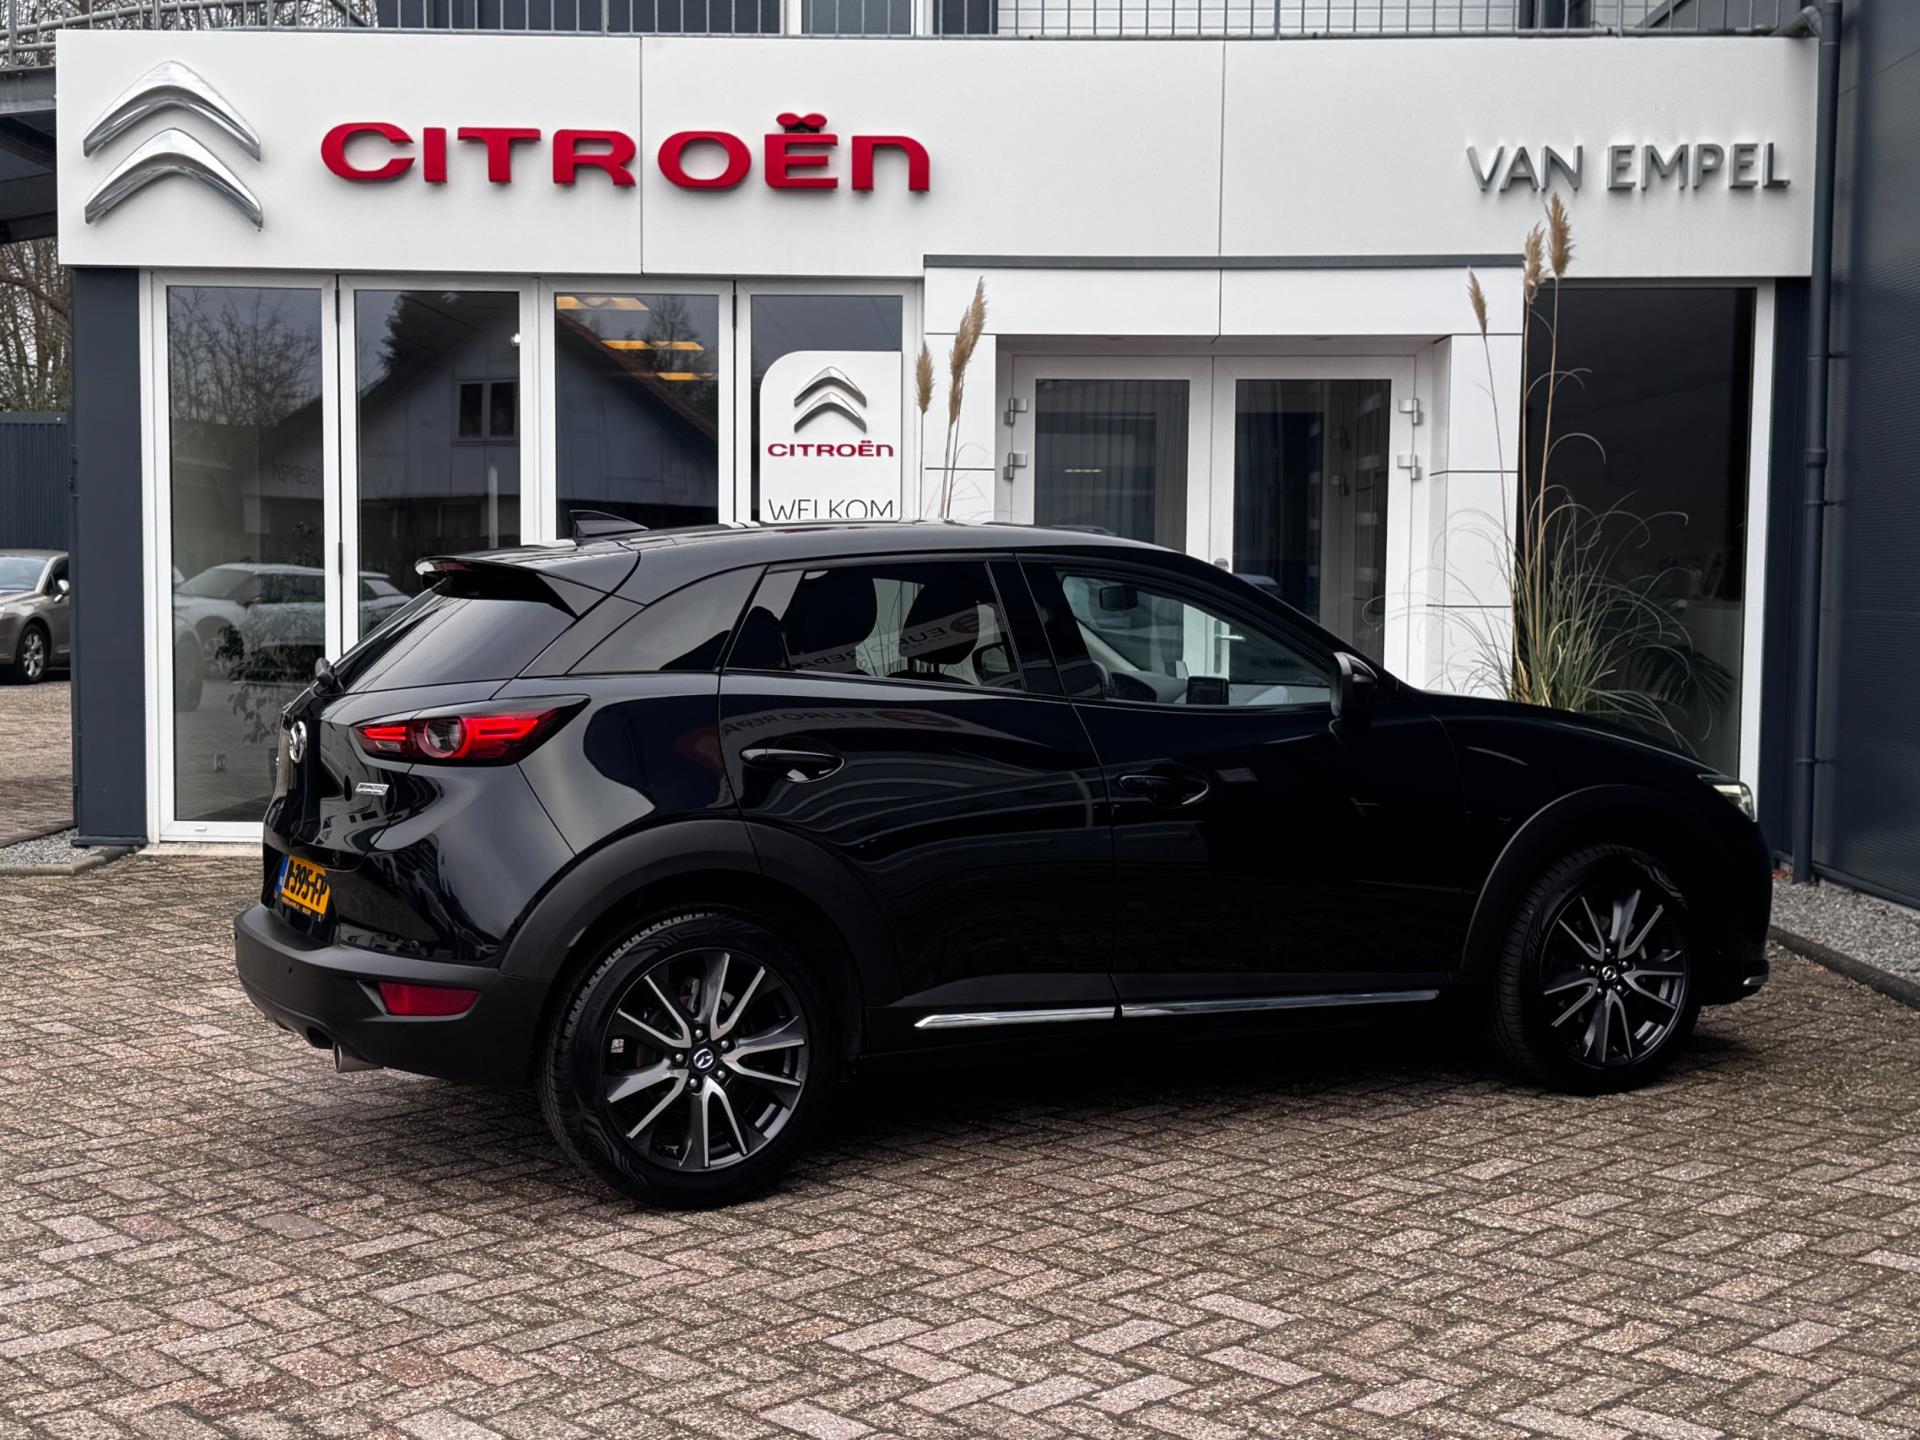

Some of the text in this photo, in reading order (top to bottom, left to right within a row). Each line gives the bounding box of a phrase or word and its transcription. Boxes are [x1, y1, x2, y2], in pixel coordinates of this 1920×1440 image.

[1466, 142, 1791, 192] VAN EMPEL
[768, 499, 893, 521] WELKOM
